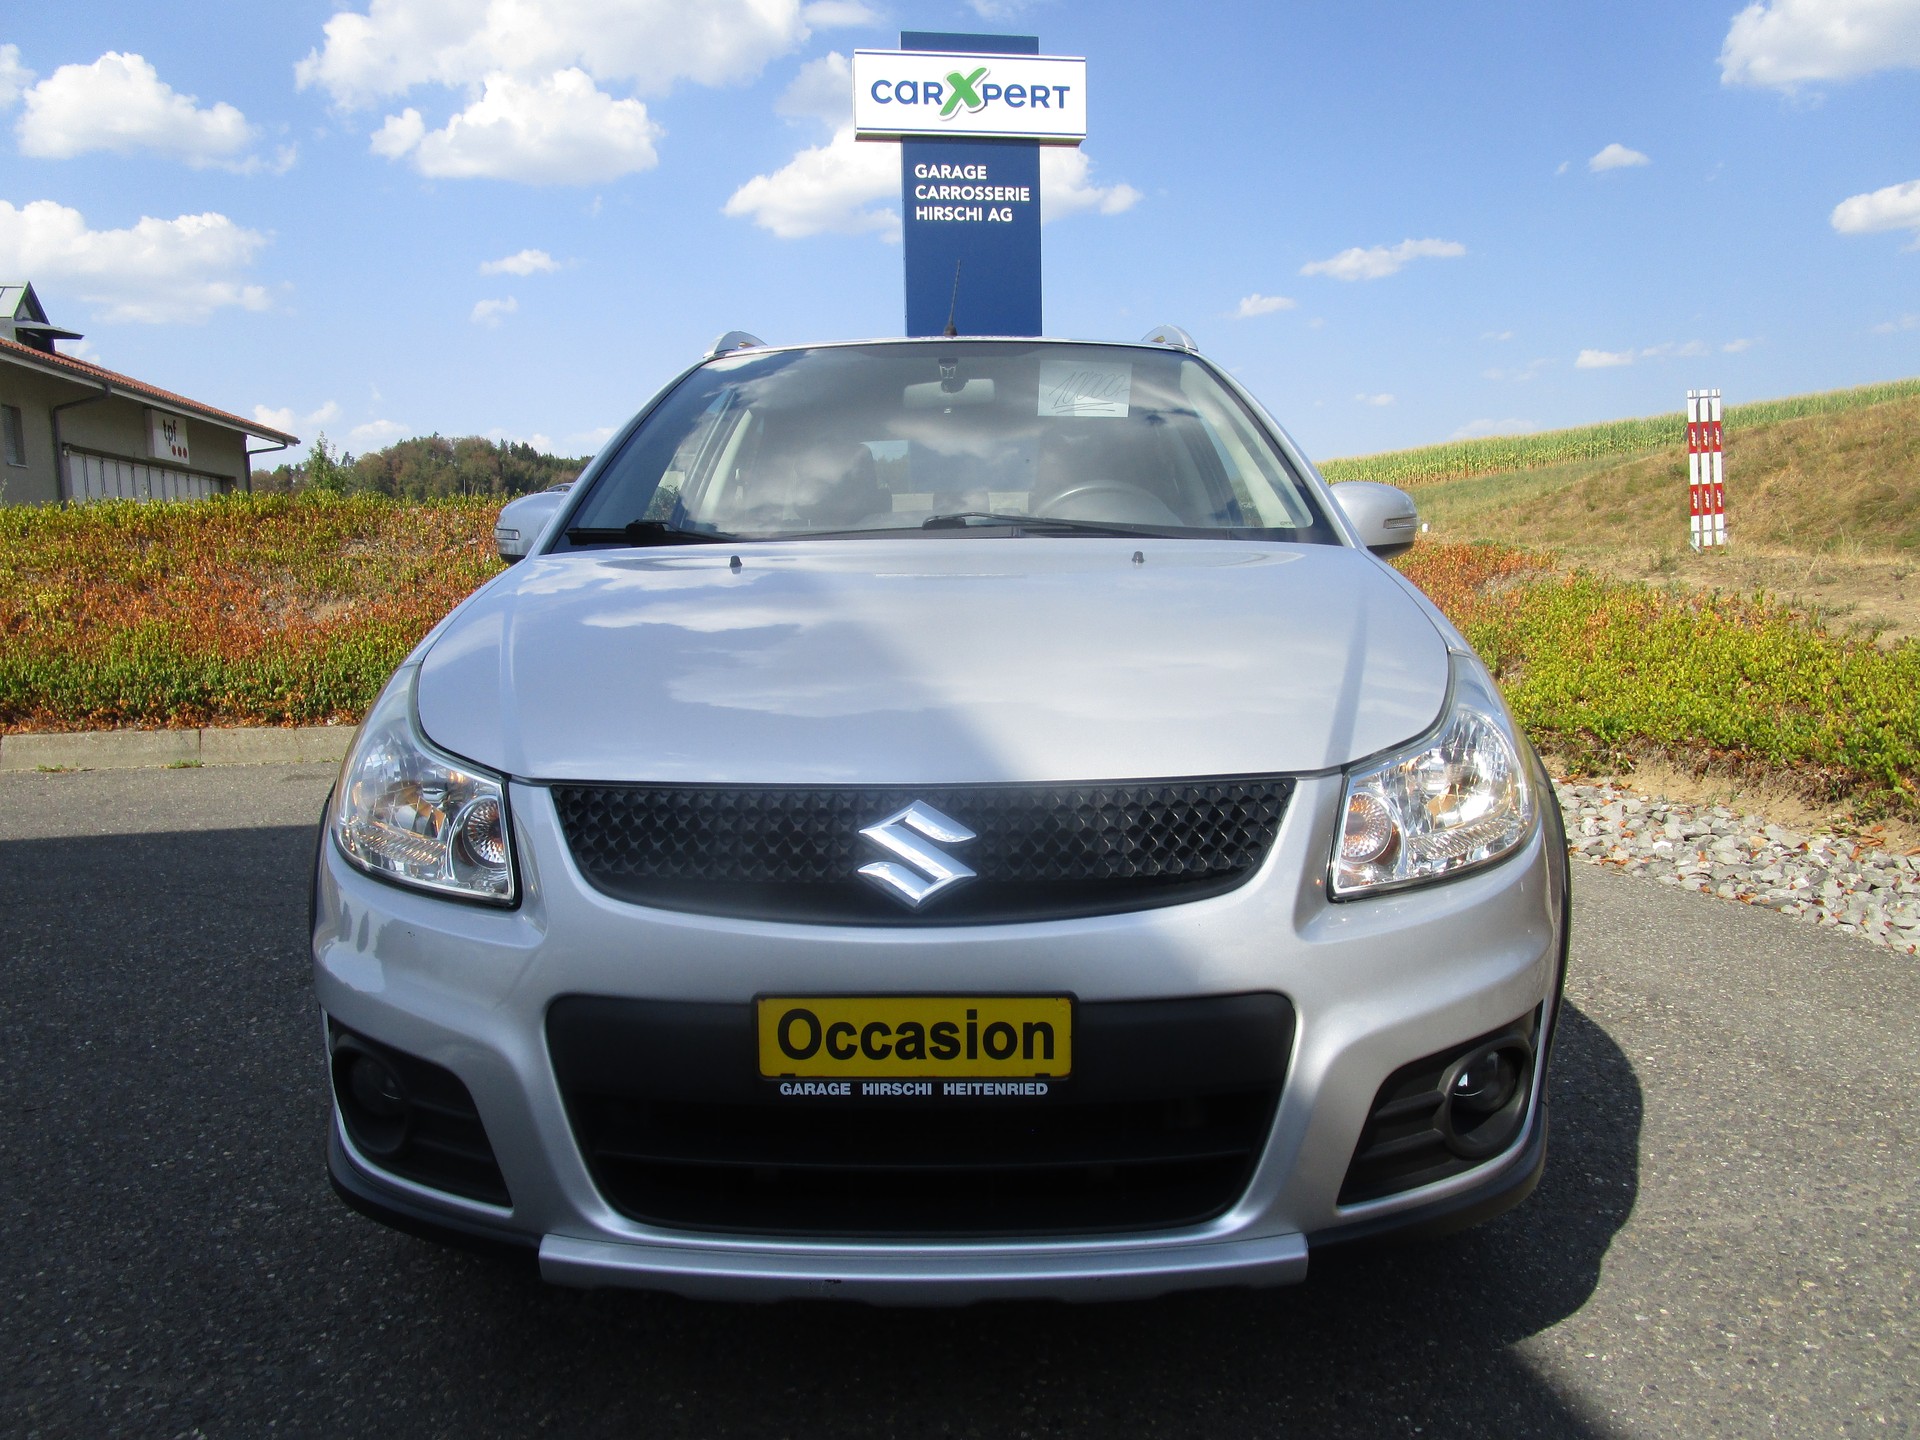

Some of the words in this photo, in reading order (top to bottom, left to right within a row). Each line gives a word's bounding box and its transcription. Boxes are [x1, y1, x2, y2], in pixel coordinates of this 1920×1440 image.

[914, 163, 988, 180] GARAGE
[914, 184, 1031, 202] CARROSSERIE
[915, 205, 983, 221] HIRSCHI
[987, 207, 1013, 222] AG
[162, 419, 177, 447] tpf
[777, 1008, 1055, 1060] Occasion
[779, 1082, 851, 1096] GARAGE
[862, 1082, 932, 1096] HIRSCHI
[943, 1082, 1049, 1096] HEITENRIED
